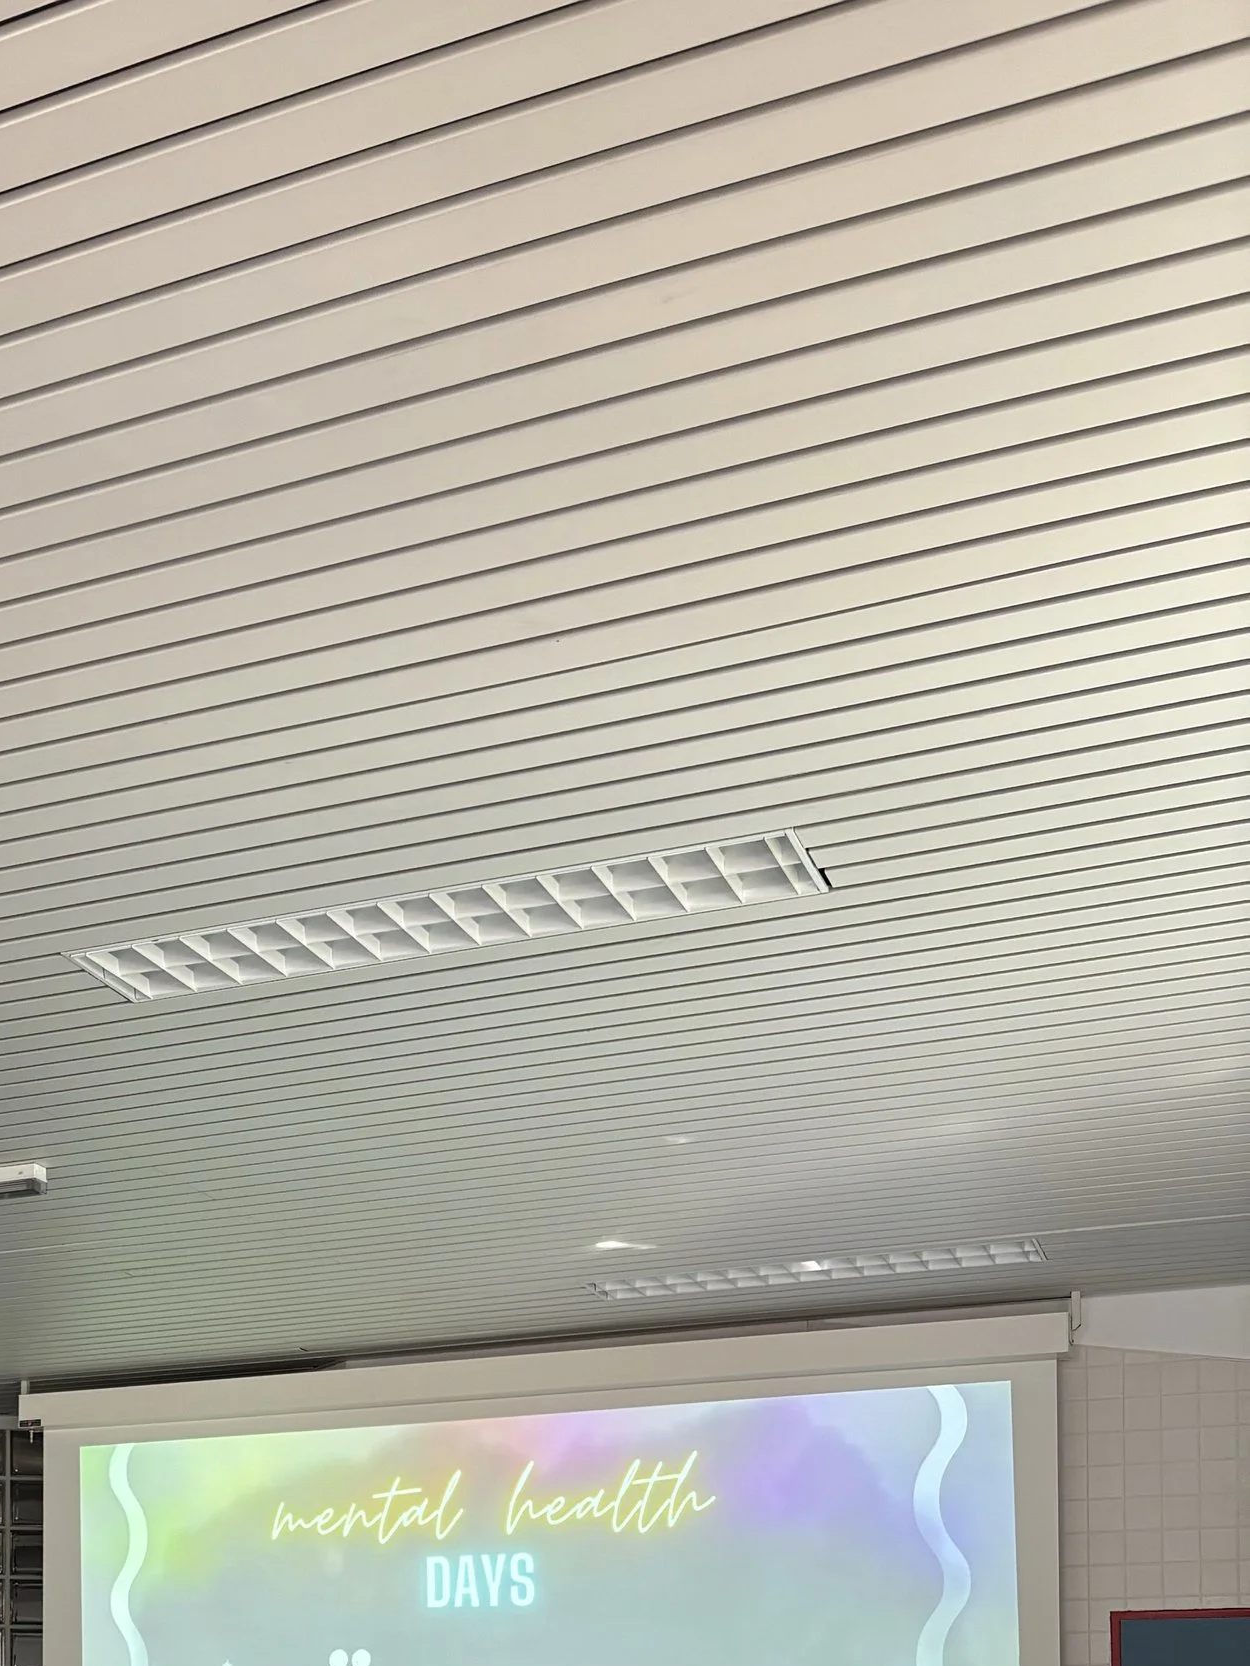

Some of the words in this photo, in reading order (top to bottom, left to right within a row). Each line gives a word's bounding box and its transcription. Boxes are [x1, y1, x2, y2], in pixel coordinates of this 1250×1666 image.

[271, 1469, 465, 1544] mental
[506, 1450, 716, 1535] health
[426, 1552, 536, 1608] DAYS
